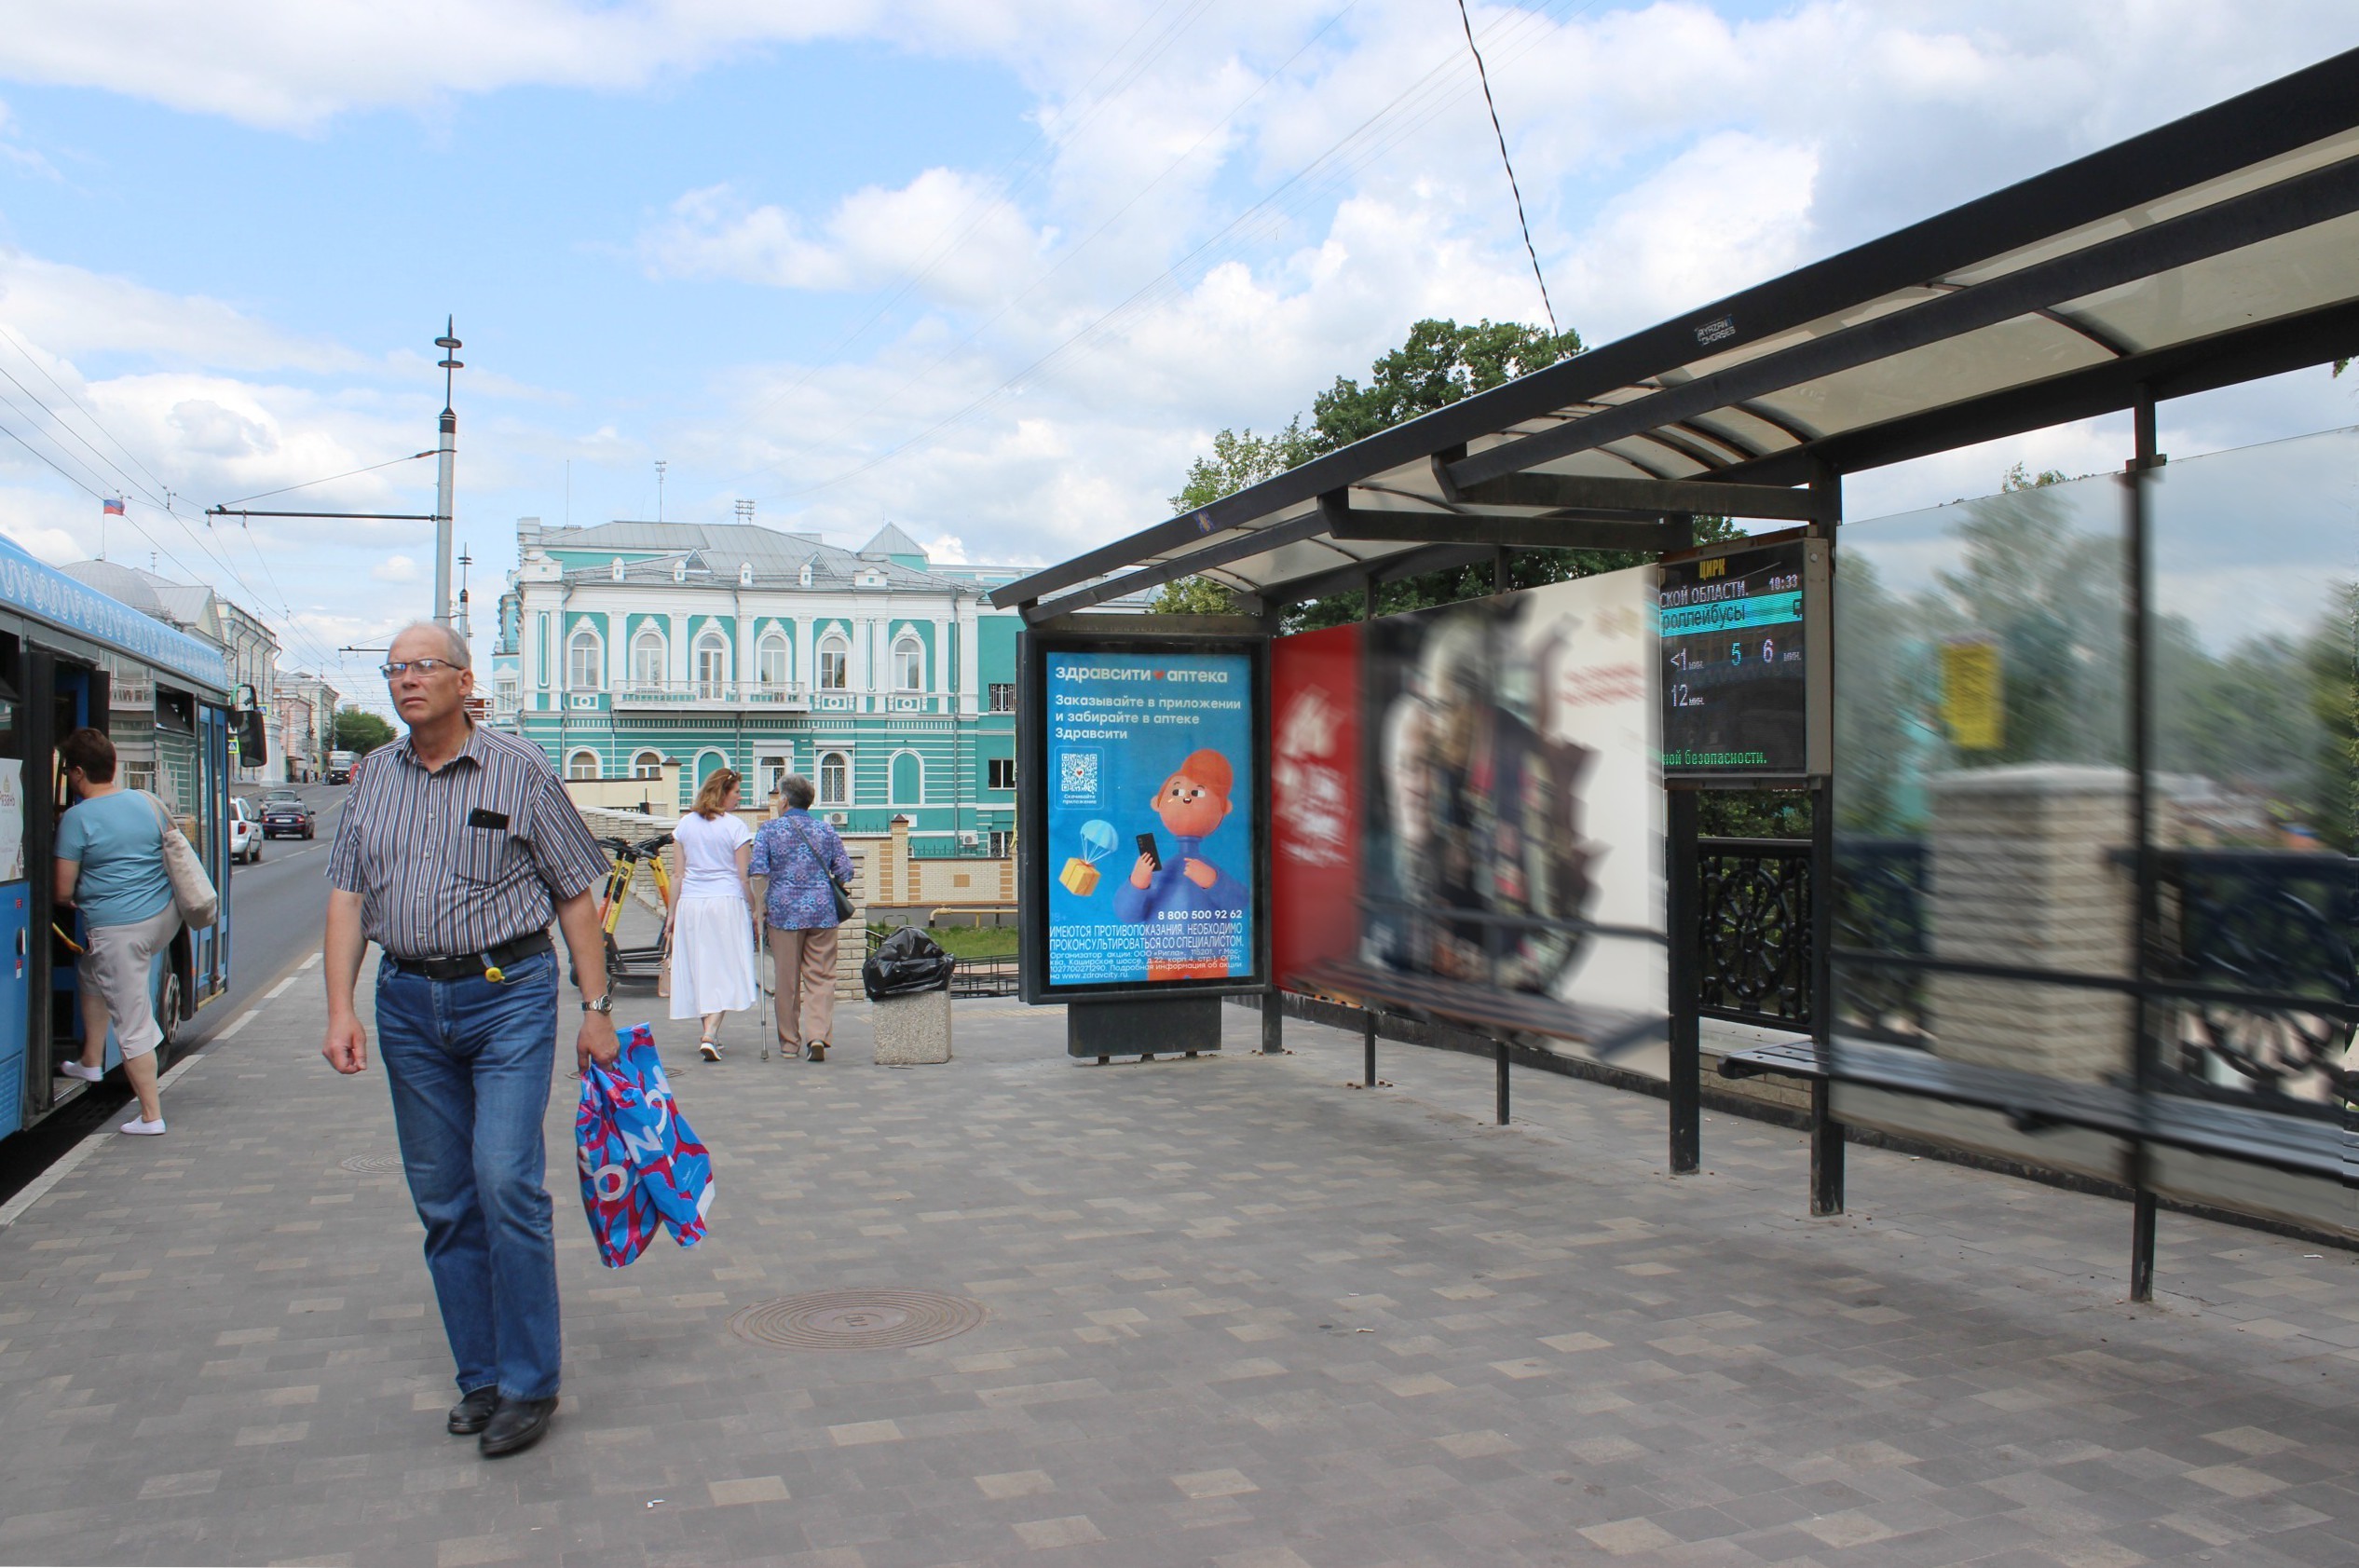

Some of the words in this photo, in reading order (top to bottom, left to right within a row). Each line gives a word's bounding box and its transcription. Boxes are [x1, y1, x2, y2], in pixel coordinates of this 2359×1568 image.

[1699, 558, 1725, 580] ЦИРК
[1768, 574, 1798, 591] 10:33
[1660, 585, 1688, 608] СКОЙ
[1691, 579, 1749, 604] ОБЛАСТИ.
[1660, 604, 1745, 633] роллейбусы
[1731, 642, 1741, 665] 5
[1762, 638, 1774, 663] 6
[1056, 666, 1151, 683] здравсити
[1166, 669, 1228, 683] аптека
[1056, 694, 1144, 707] Заказывайте
[1148, 699, 1155, 707] в
[1159, 698, 1241, 710] приложении
[1670, 684, 1688, 707] 12
[1056, 713, 1063, 722] и
[1068, 711, 1139, 725] забирайте
[1142, 715, 1150, 723] в
[1153, 715, 1199, 724] аптеке
[1056, 728, 1127, 741] Здравсити
[1684, 749, 1767, 765] безопасности.
[1157, 911, 1165, 920] 8
[1167, 910, 1188, 920] 800
[1191, 910, 1211, 920] 500
[1214, 909, 1227, 919] 92
[1230, 909, 1242, 919] 62
[1050, 925, 1091, 937] ИМЕЮТСЯ
[1094, 923, 1184, 936] ПРОТИВОПОКАЗАНИЯ.
[1187, 922, 1243, 935] НЕОБХОДИМО
[1050, 937, 1161, 950] ПРОКОНСУЛЬТИРОВАТЬСЯ
[1162, 936, 1174, 948] СО
[1176, 935, 1244, 948] СПЕЦИАЛИСТОМ.
[1050, 951, 1102, 960] Организатор
[1070, 959, 1113, 967] Каширское
[1155, 962, 1206, 971] информация
